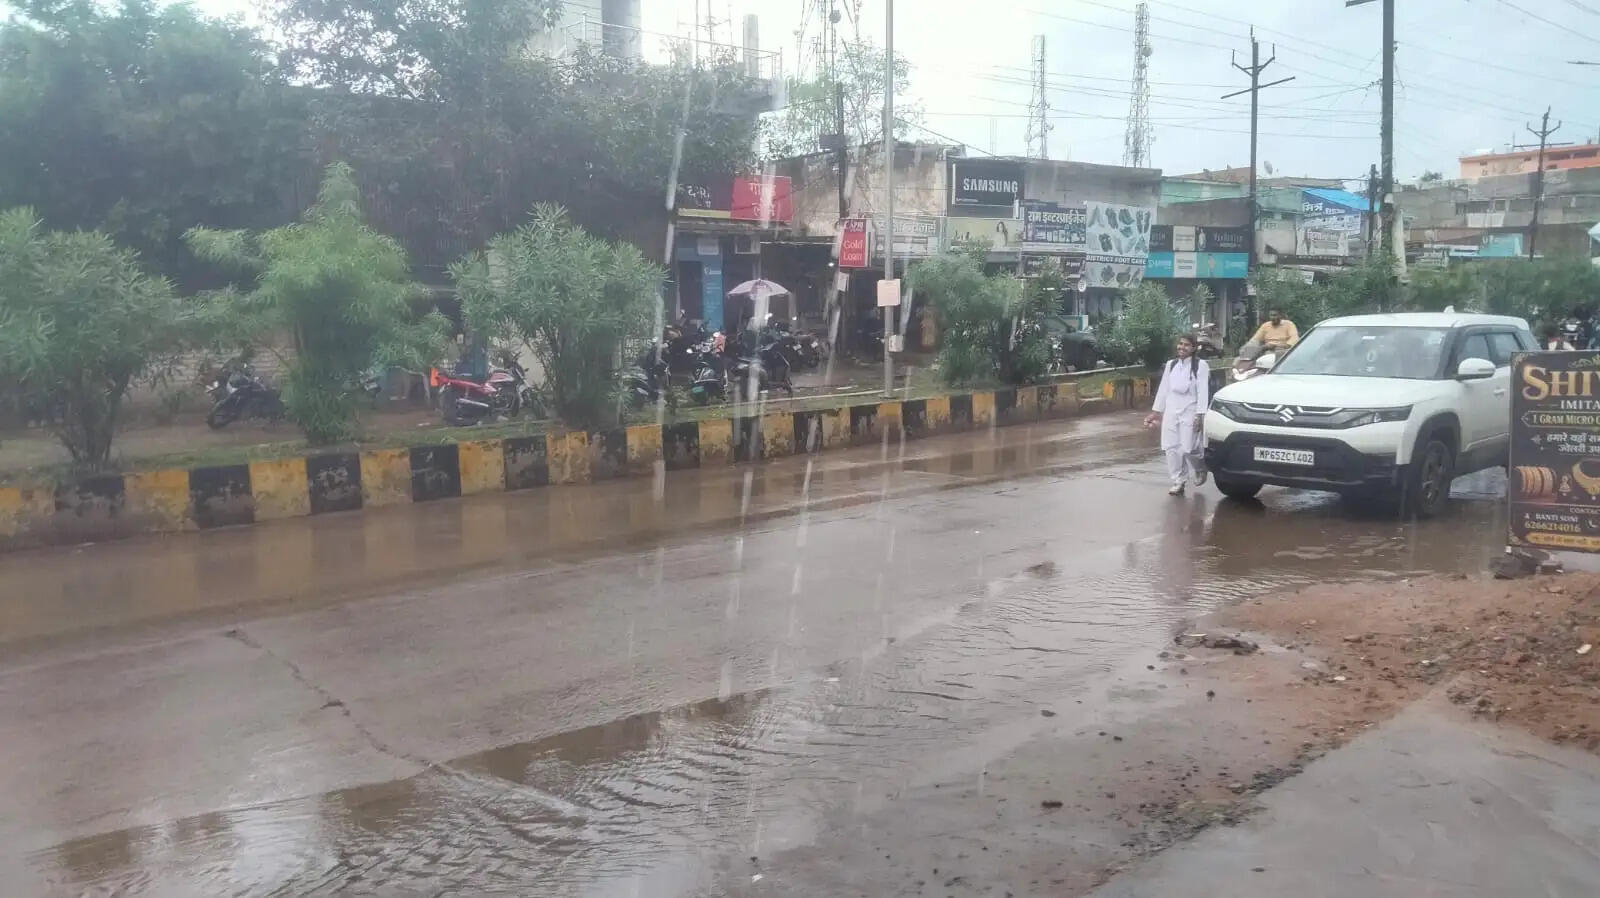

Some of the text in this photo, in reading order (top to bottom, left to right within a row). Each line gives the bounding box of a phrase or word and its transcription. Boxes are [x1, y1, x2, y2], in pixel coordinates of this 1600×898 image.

[963, 178, 1018, 193] SAMSUNG
[1028, 211, 1042, 222] राम
[844, 240, 863, 249] Gold
[844, 252, 862, 260] Loan
[1539, 414, 1563, 425] GRAM
[1565, 414, 1594, 425] MICRO
[1546, 431, 1568, 442] हमारे
[1259, 449, 1313, 464] MP65ZC1402
